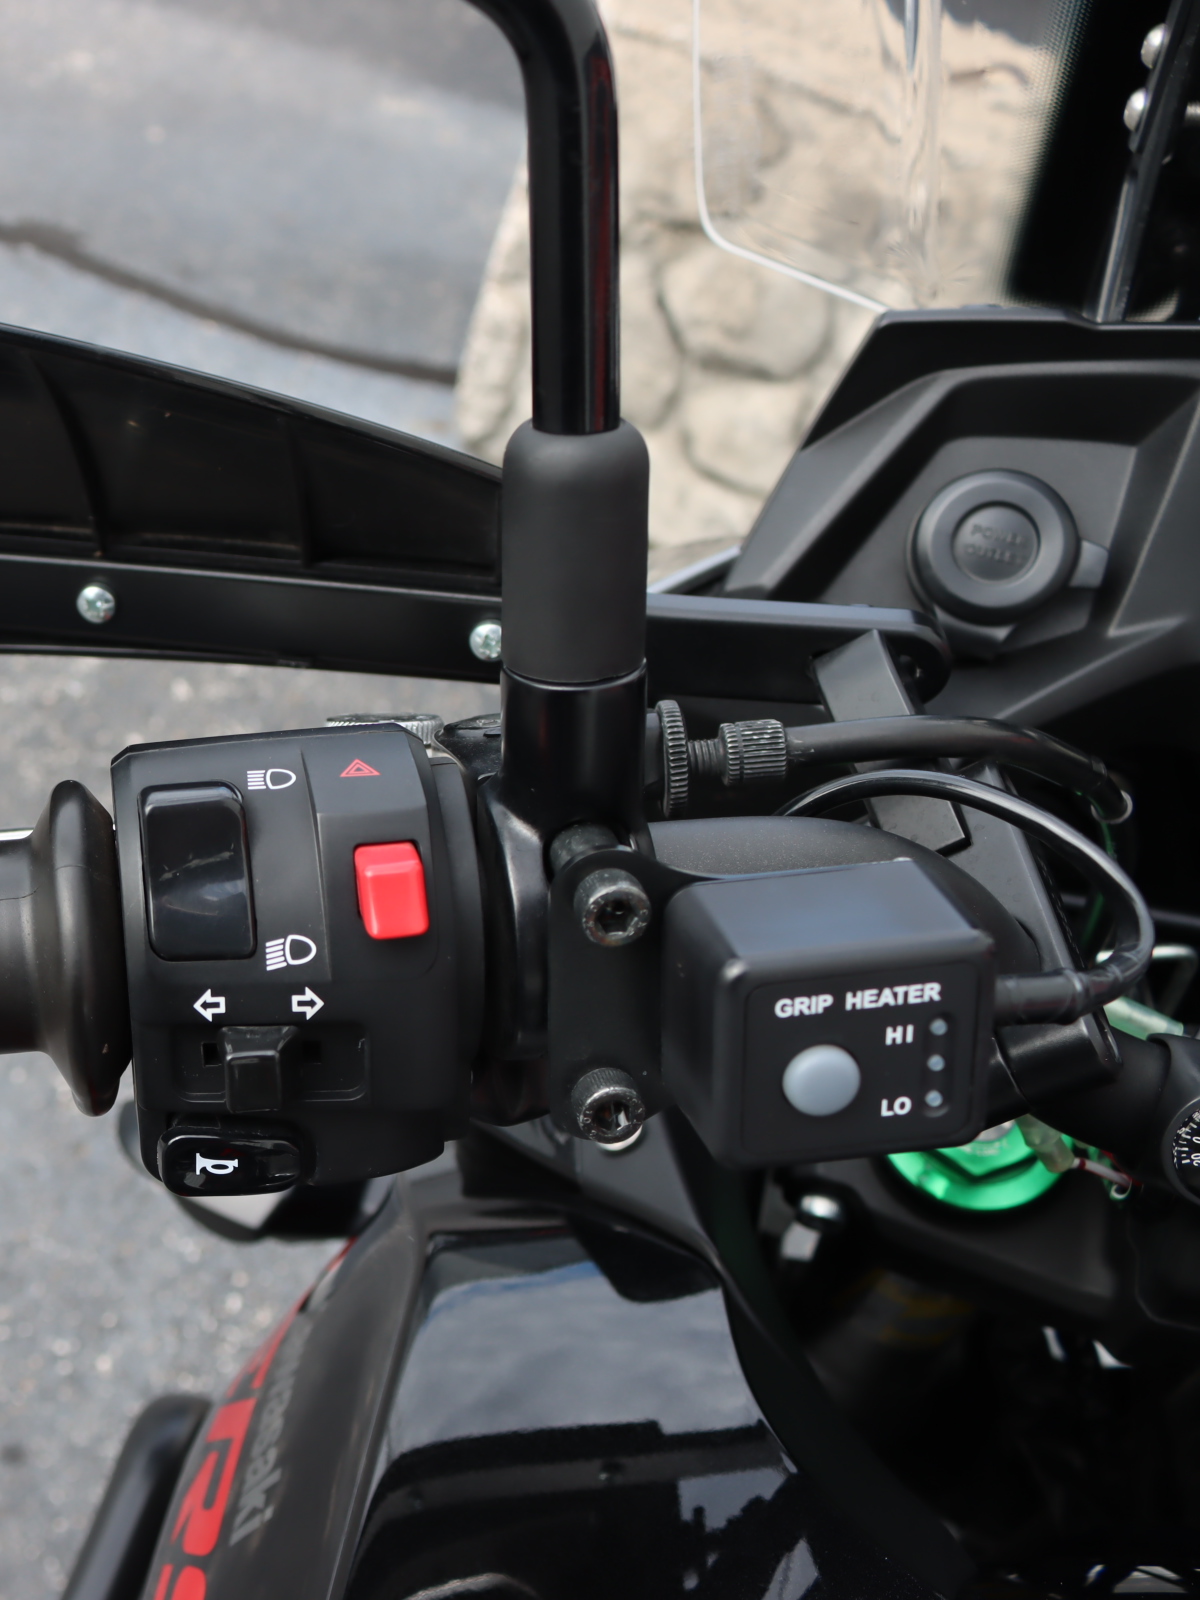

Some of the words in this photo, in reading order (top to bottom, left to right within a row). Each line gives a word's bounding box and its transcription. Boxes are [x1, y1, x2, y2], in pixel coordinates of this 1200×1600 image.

[774, 994, 834, 1018] GRIP
[845, 982, 942, 1011] HEATER
[885, 1024, 915, 1046] HI
[881, 1096, 912, 1117] LO
